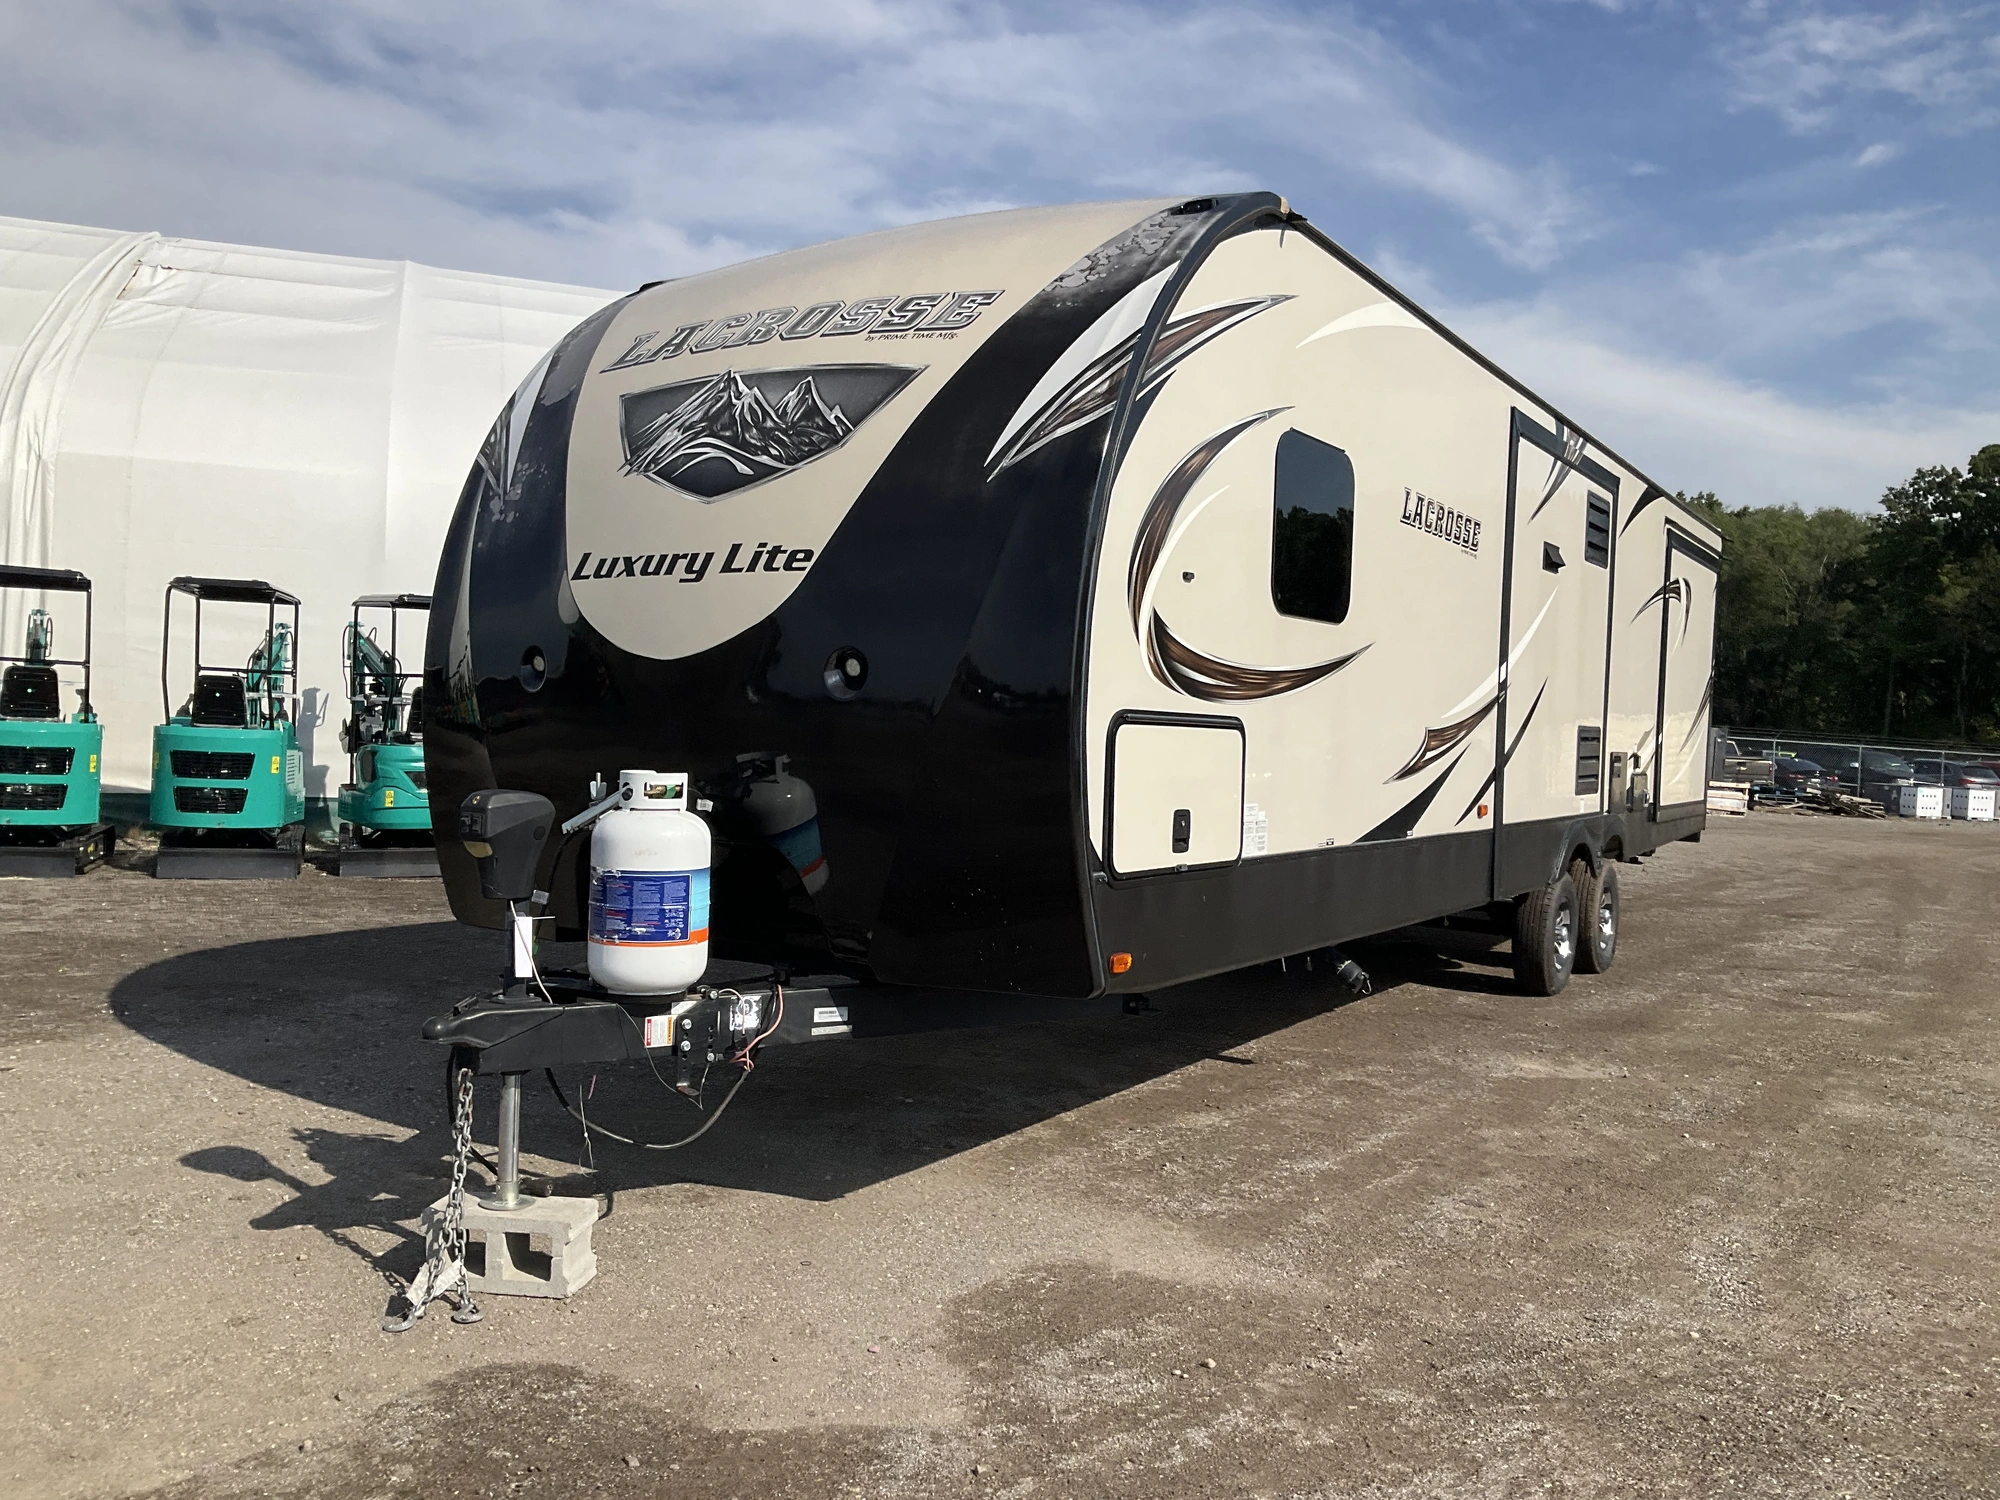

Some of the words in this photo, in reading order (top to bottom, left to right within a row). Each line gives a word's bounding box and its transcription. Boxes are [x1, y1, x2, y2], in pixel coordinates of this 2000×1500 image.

[599, 290, 1005, 374] LACROSSE
[865, 334, 877, 342] by
[1400, 486, 1481, 552] LACROSSE
[570, 552, 715, 583] Luxury
[718, 542, 815, 574] Lite
